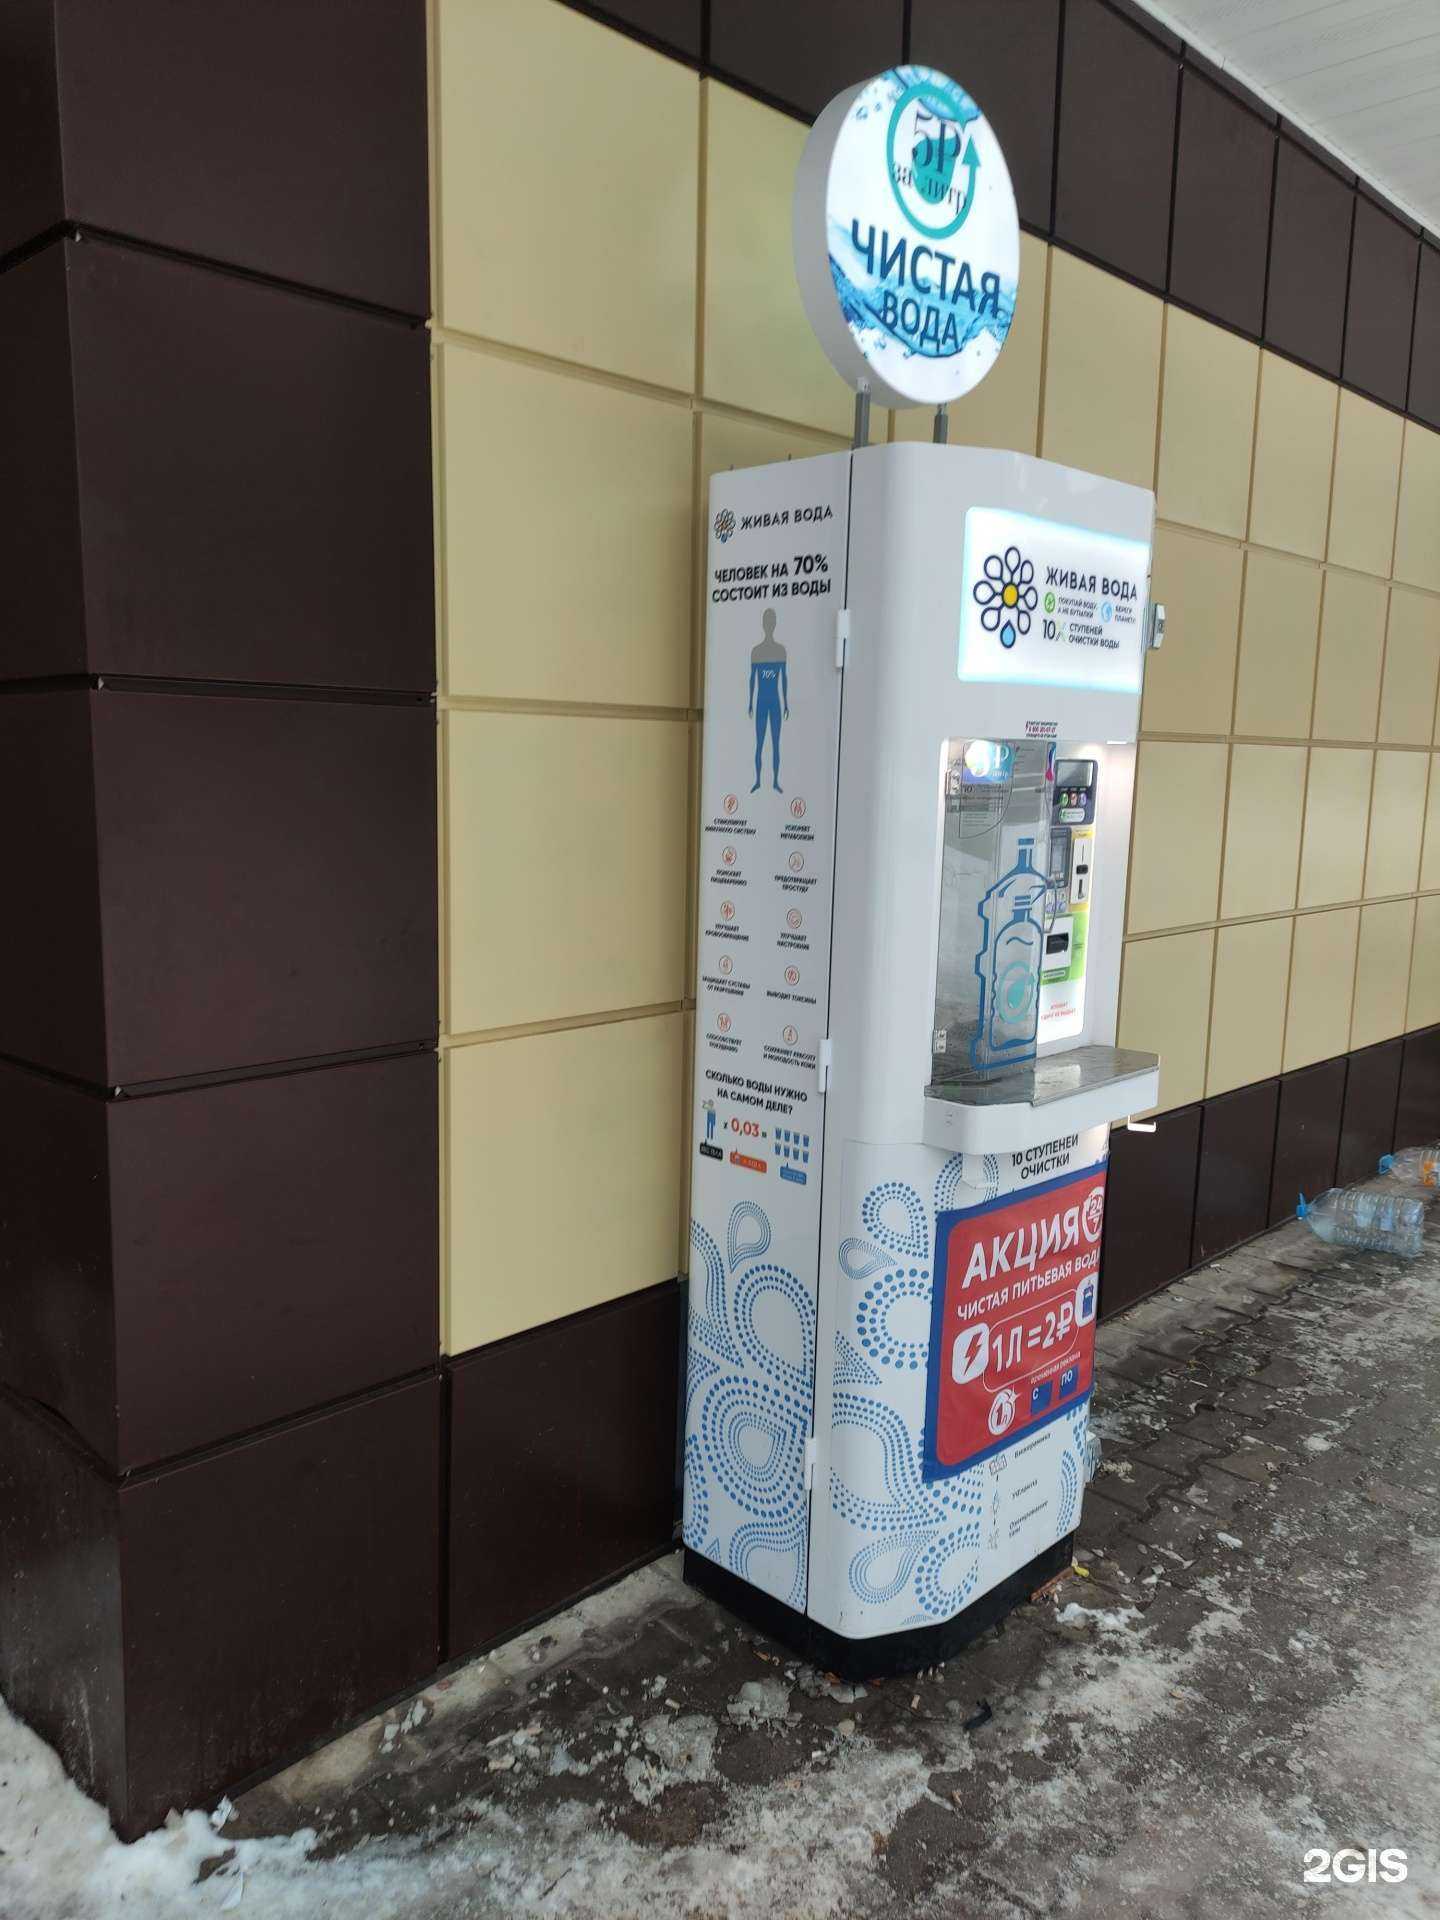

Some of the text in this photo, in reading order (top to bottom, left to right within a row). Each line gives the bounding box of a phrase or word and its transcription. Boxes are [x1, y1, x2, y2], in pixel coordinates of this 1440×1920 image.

[851, 218, 1000, 317] ЧИСТАЯ
[880, 290, 960, 351] ВОДА
[740, 504, 833, 530] ЖИВАЯ ВОДА
[714, 553, 829, 583] ЧЕЛОВЕК НА 70%
[712, 578, 832, 603] СОСТОИТ ИЗ ВОДЫ
[1045, 566, 1138, 601] ЖИВАЯ ВОДА
[1068, 634, 1120, 650] ОЧИСТКИ ВОДЫ
[1069, 623, 1103, 635] СТУПЕНЕЙ
[705, 1069, 808, 1102] СКОЛЬКО ВОДЫ НУЖНО
[717, 1088, 793, 1115] НА САМОМ ДЕЛЕ?
[731, 1117, 760, 1138] 0,03
[1011, 1151, 1023, 1167] 10
[1021, 1152, 1070, 1180] ОЧИСТКИ
[961, 1205, 1080, 1289] АКЦИЯ
[957, 1292, 1010, 1321] ЧИСТАЯ
[1011, 1260, 1072, 1301] ПИТЬЕВАЯ
[1061, 1369, 1073, 1386] ПО
[1032, 1387, 1039, 1400] С
